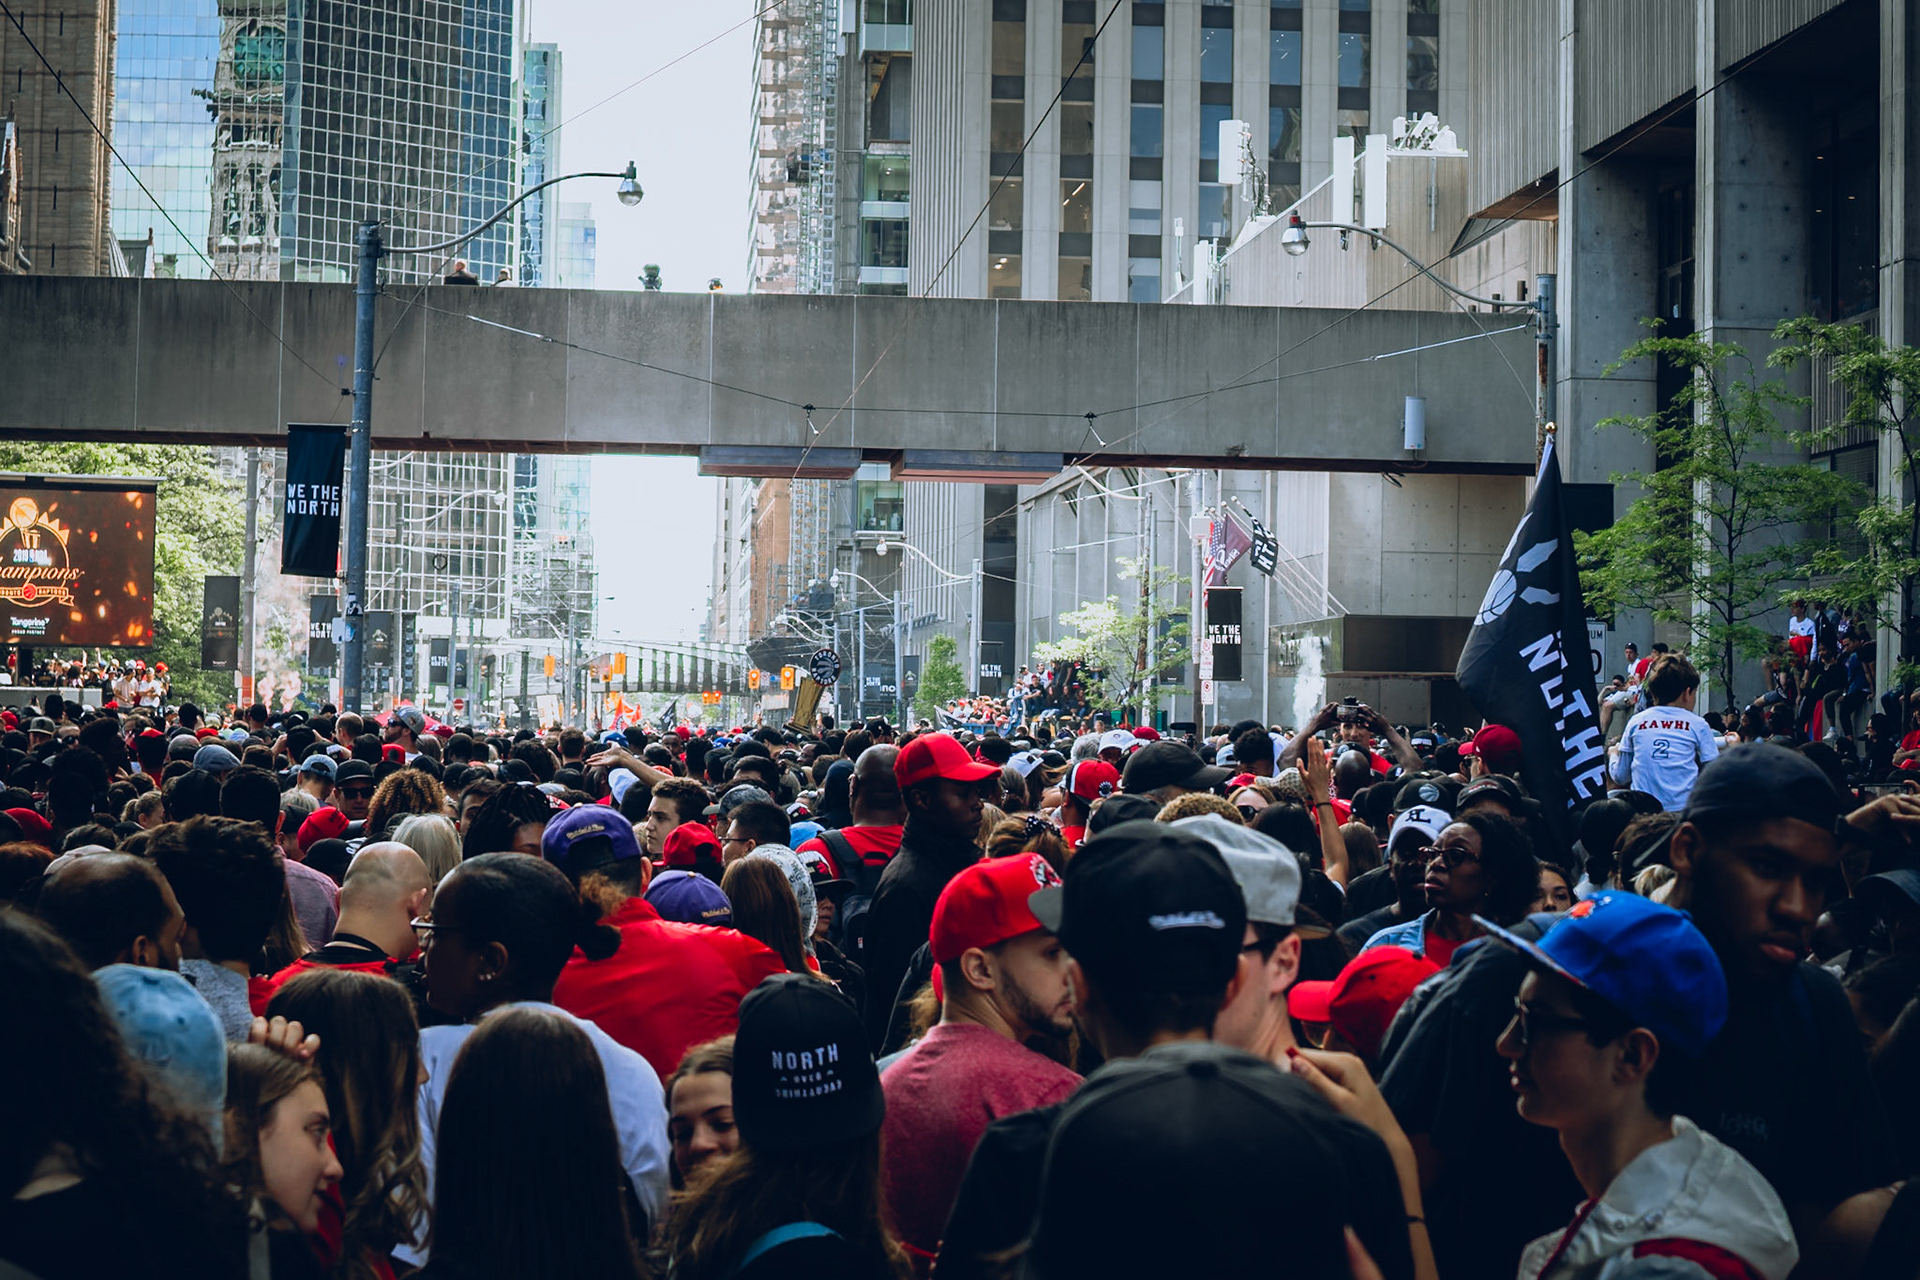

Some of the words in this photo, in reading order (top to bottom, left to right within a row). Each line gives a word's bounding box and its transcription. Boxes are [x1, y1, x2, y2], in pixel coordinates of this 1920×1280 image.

[287, 484, 305, 498] WE
[311, 485, 340, 500] THE
[287, 499, 339, 517] NORTH
[0, 566, 85, 587] ampions
[321, 622, 332, 631] TH
[1222, 625, 1241, 635] THE
[310, 630, 332, 638] NORT
[1209, 635, 1241, 645] NORTH
[1638, 720, 1691, 731] KAWHI
[1652, 739, 1670, 758] 2
[772, 1042, 839, 1070] NORTH
